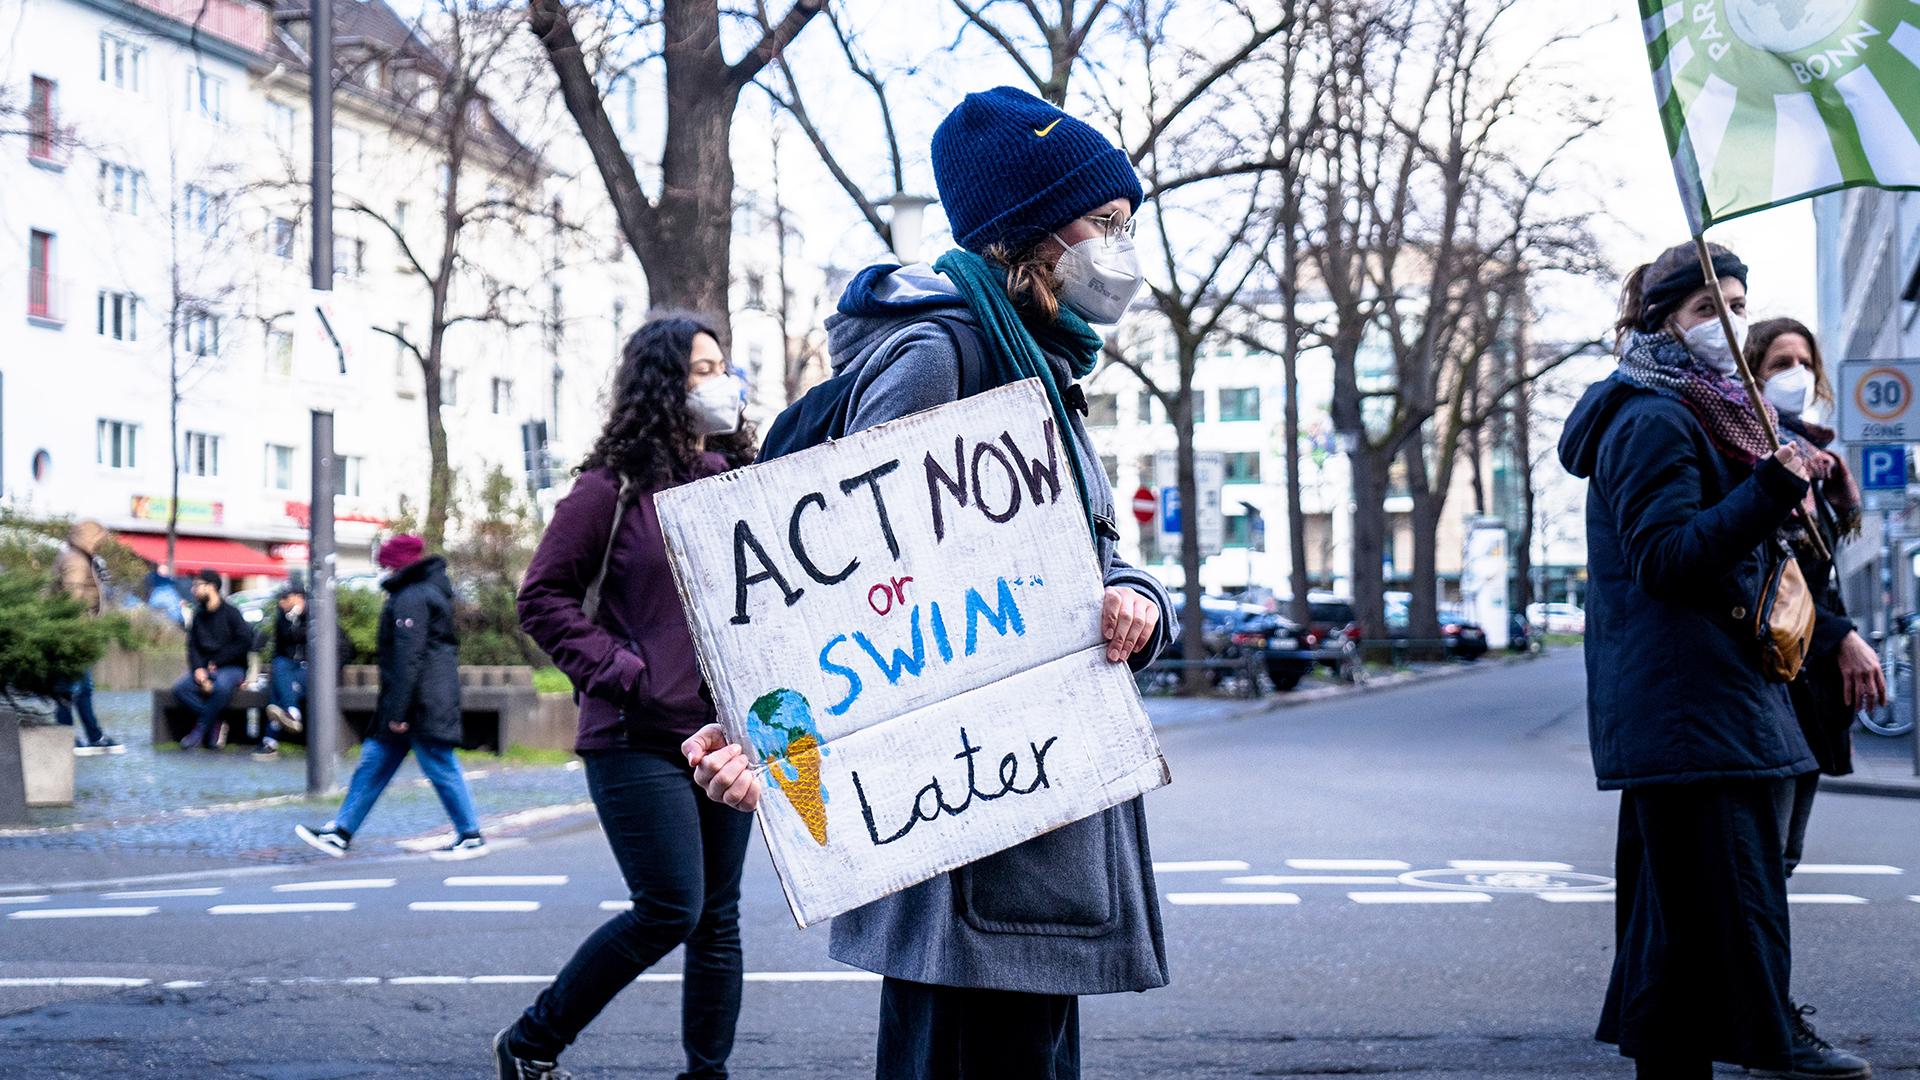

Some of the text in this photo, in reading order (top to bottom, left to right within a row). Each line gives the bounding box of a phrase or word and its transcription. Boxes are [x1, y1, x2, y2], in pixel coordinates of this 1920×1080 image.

[1790, 19, 1881, 85] BONN
[1866, 380, 1901, 407] 30
[1862, 422, 1906, 437] ZONE
[1869, 452, 1893, 483] P
[730, 417, 1063, 625] ACT NOW
[868, 576, 914, 616] or
[819, 576, 1026, 716] SWIM
[851, 727, 1058, 846] Later
